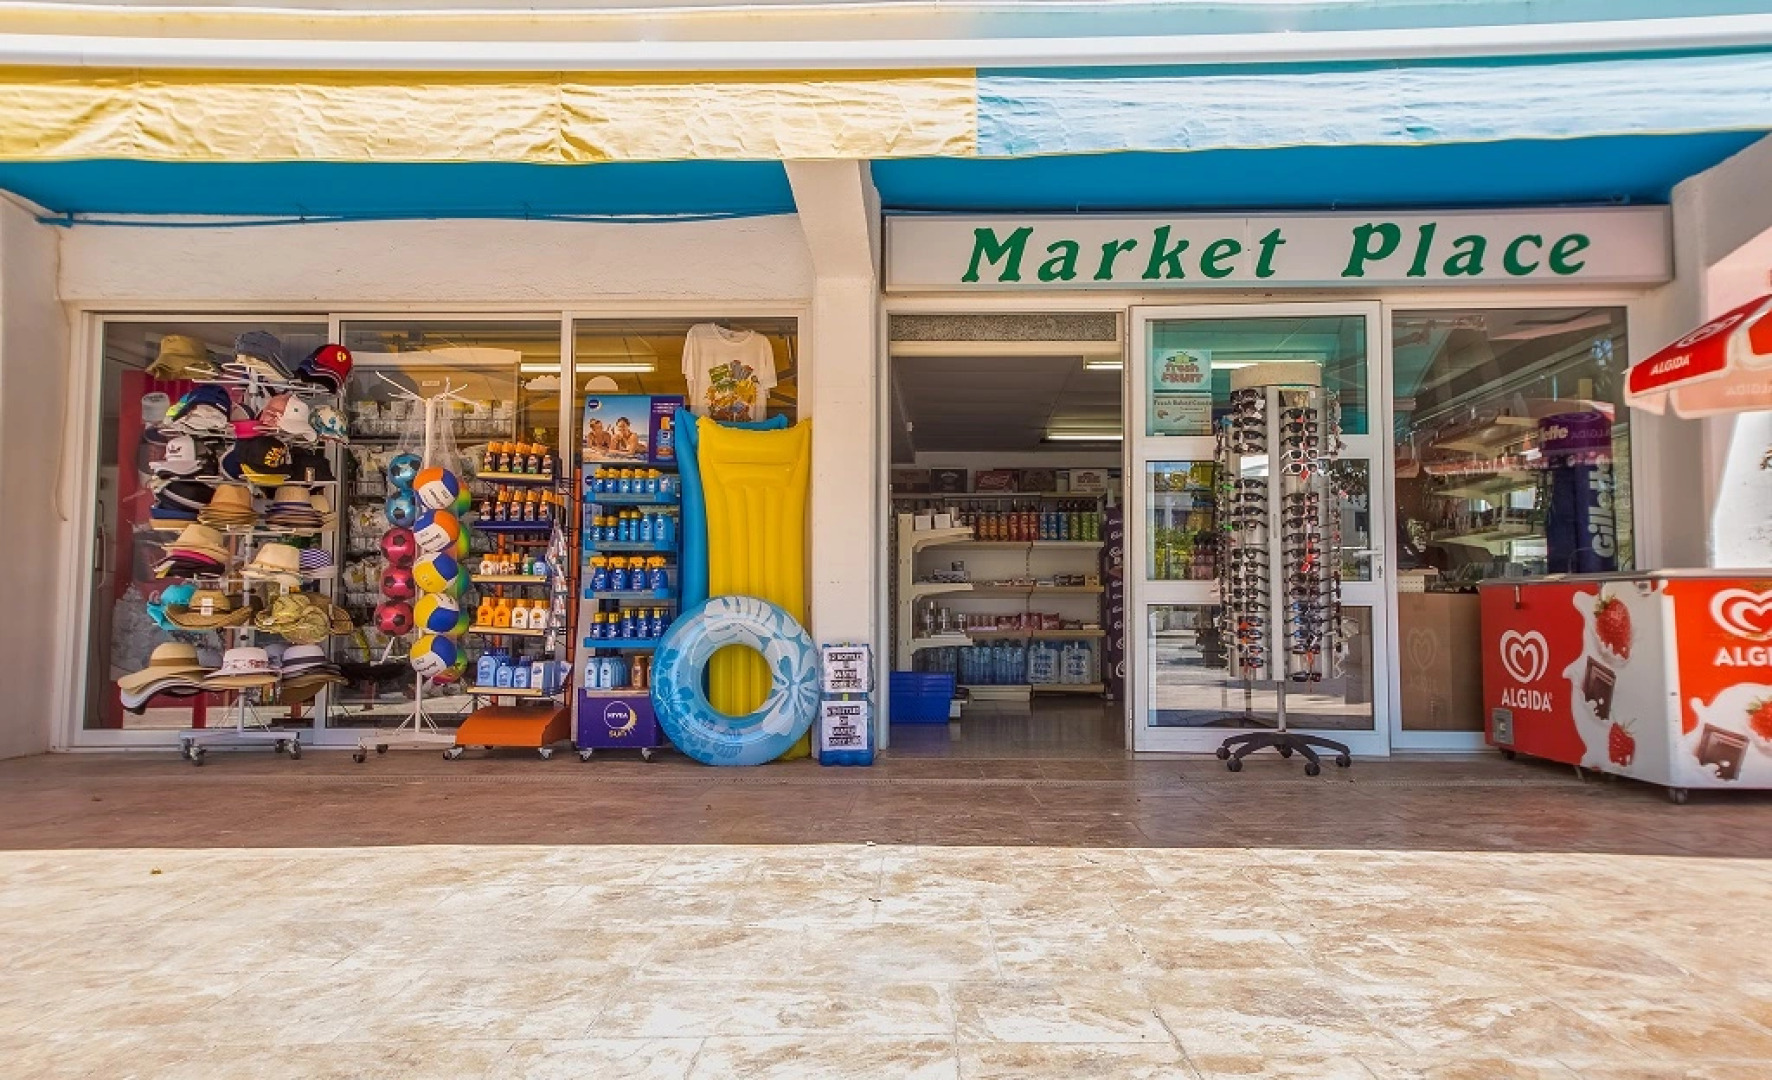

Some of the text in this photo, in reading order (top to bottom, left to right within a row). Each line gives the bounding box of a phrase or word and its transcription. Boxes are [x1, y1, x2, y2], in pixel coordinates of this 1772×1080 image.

[962, 222, 1590, 282] Market Place
[1649, 354, 1690, 376] ALGIDA
[1161, 373, 1203, 383] FRUIT
[1501, 687, 1552, 713] ALGIDA
